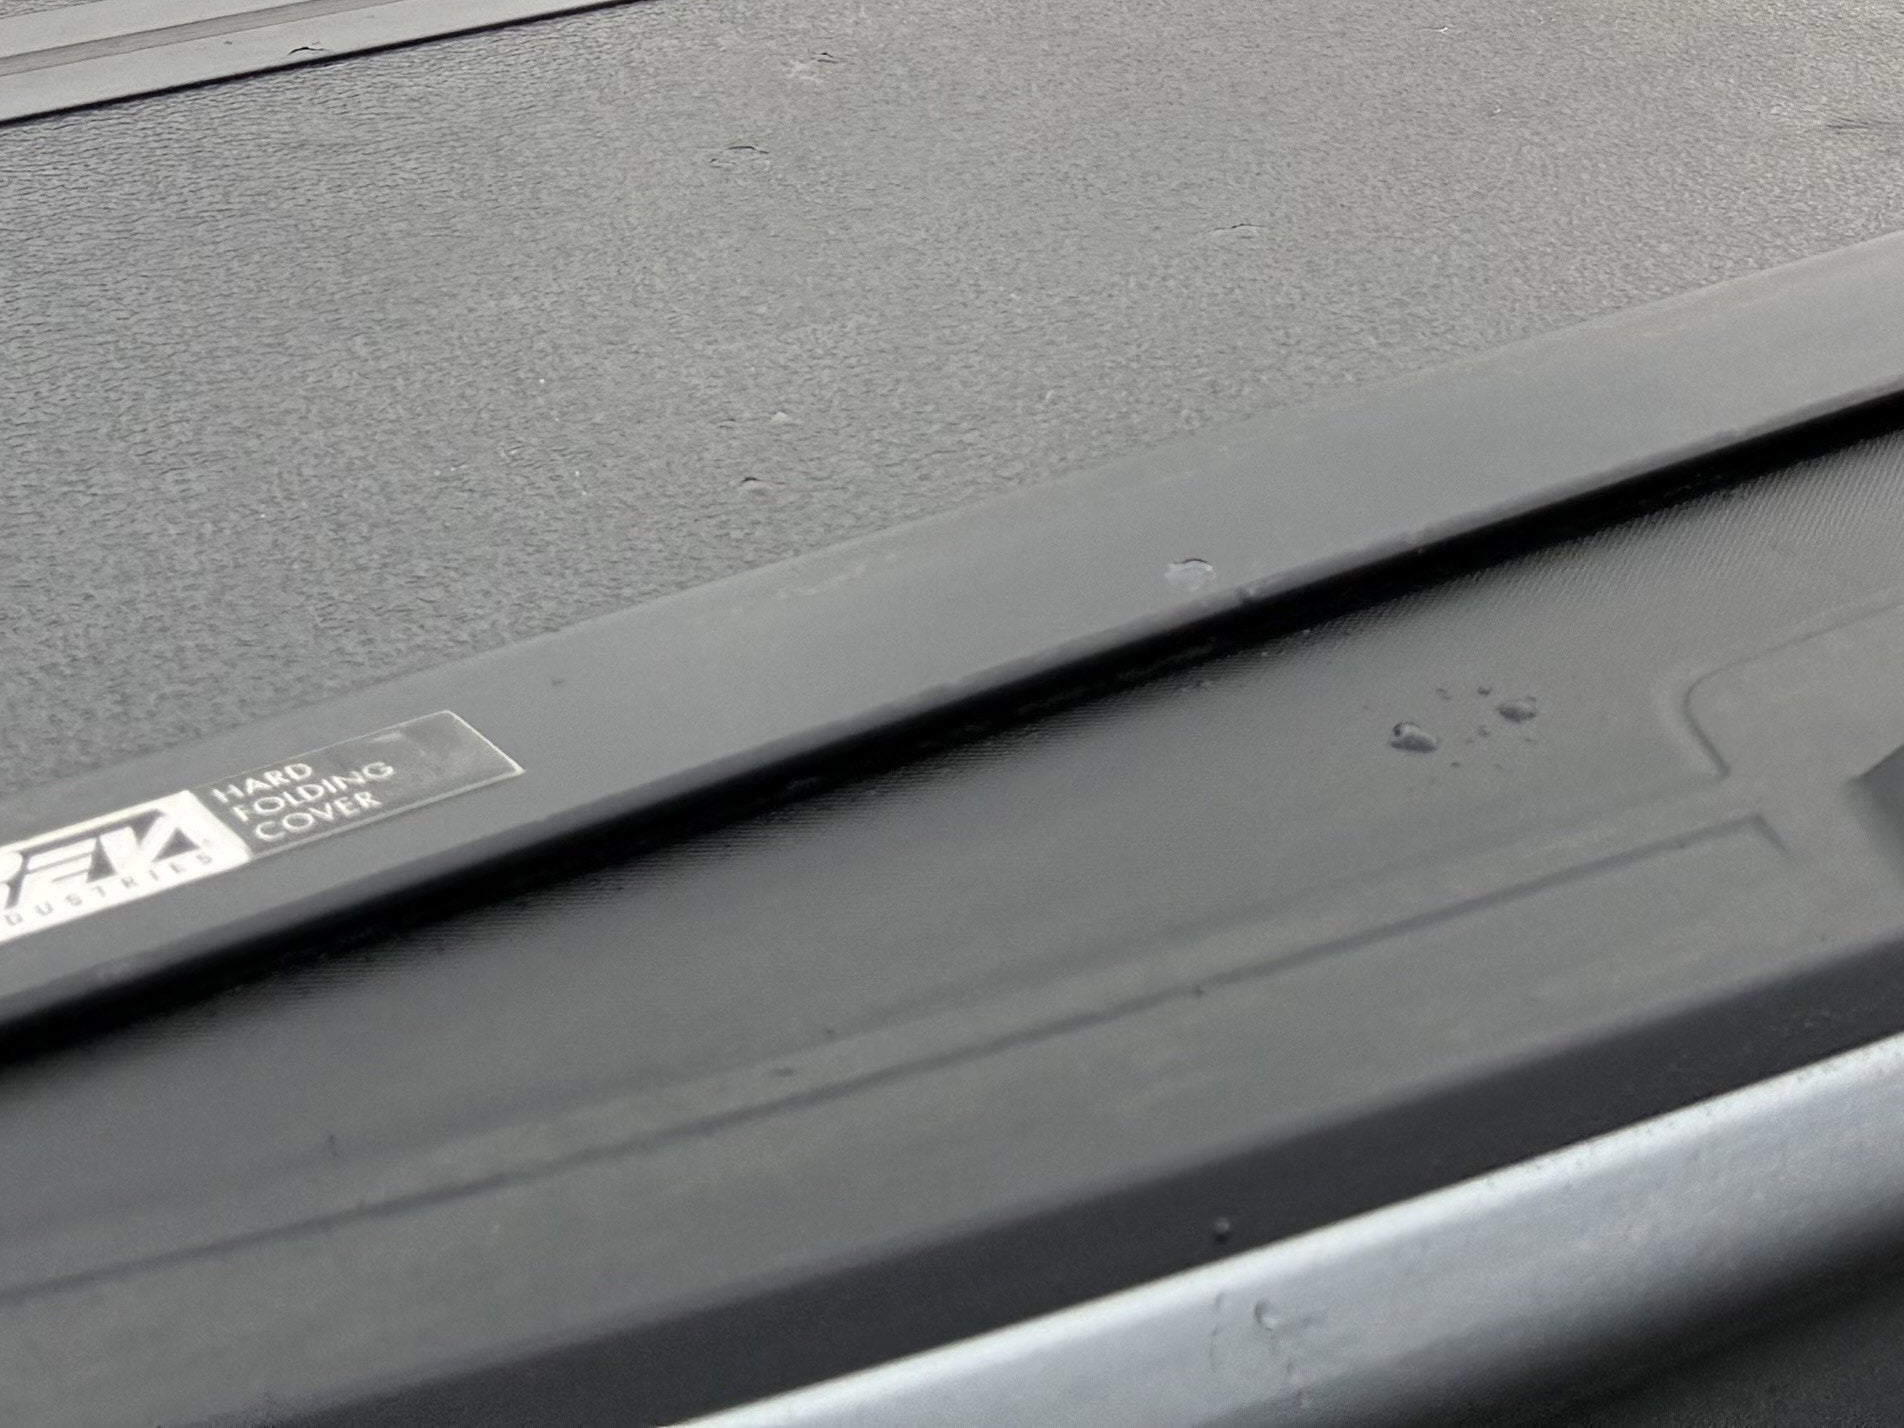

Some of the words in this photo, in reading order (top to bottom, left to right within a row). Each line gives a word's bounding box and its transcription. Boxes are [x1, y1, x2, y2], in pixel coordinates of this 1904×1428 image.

[212, 762, 313, 804] HARD
[232, 760, 395, 833] FOLDING
[253, 791, 382, 842] COVER
